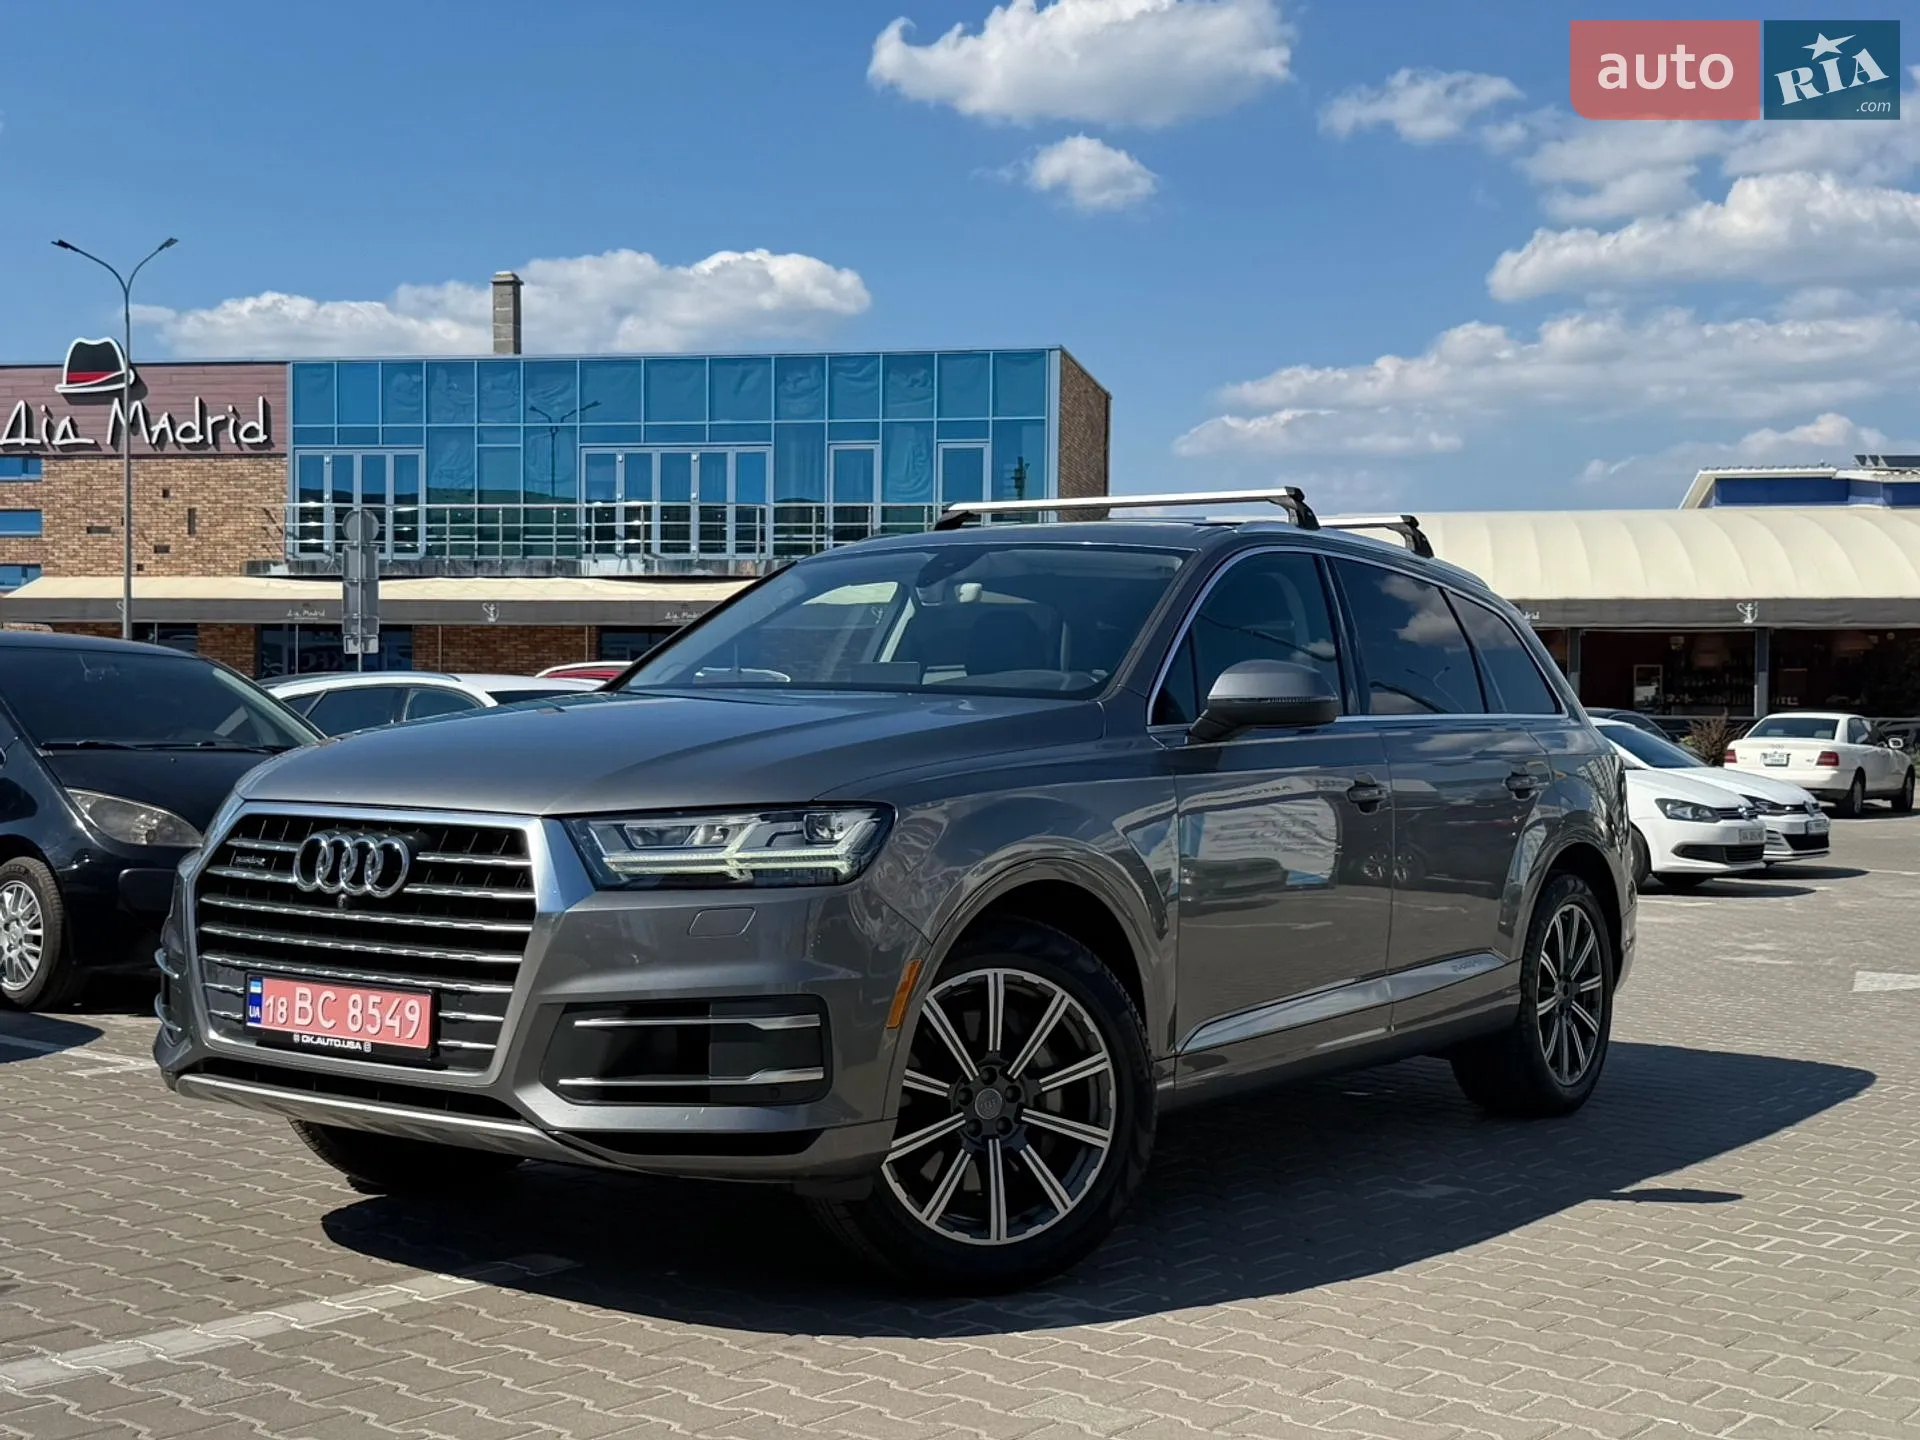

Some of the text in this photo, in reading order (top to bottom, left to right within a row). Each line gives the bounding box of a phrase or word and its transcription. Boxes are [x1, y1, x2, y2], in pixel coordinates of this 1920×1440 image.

[106, 395, 268, 445] Madrid
[249, 1005, 261, 1018] UA
[265, 987, 422, 1039] 18 BC 8549
